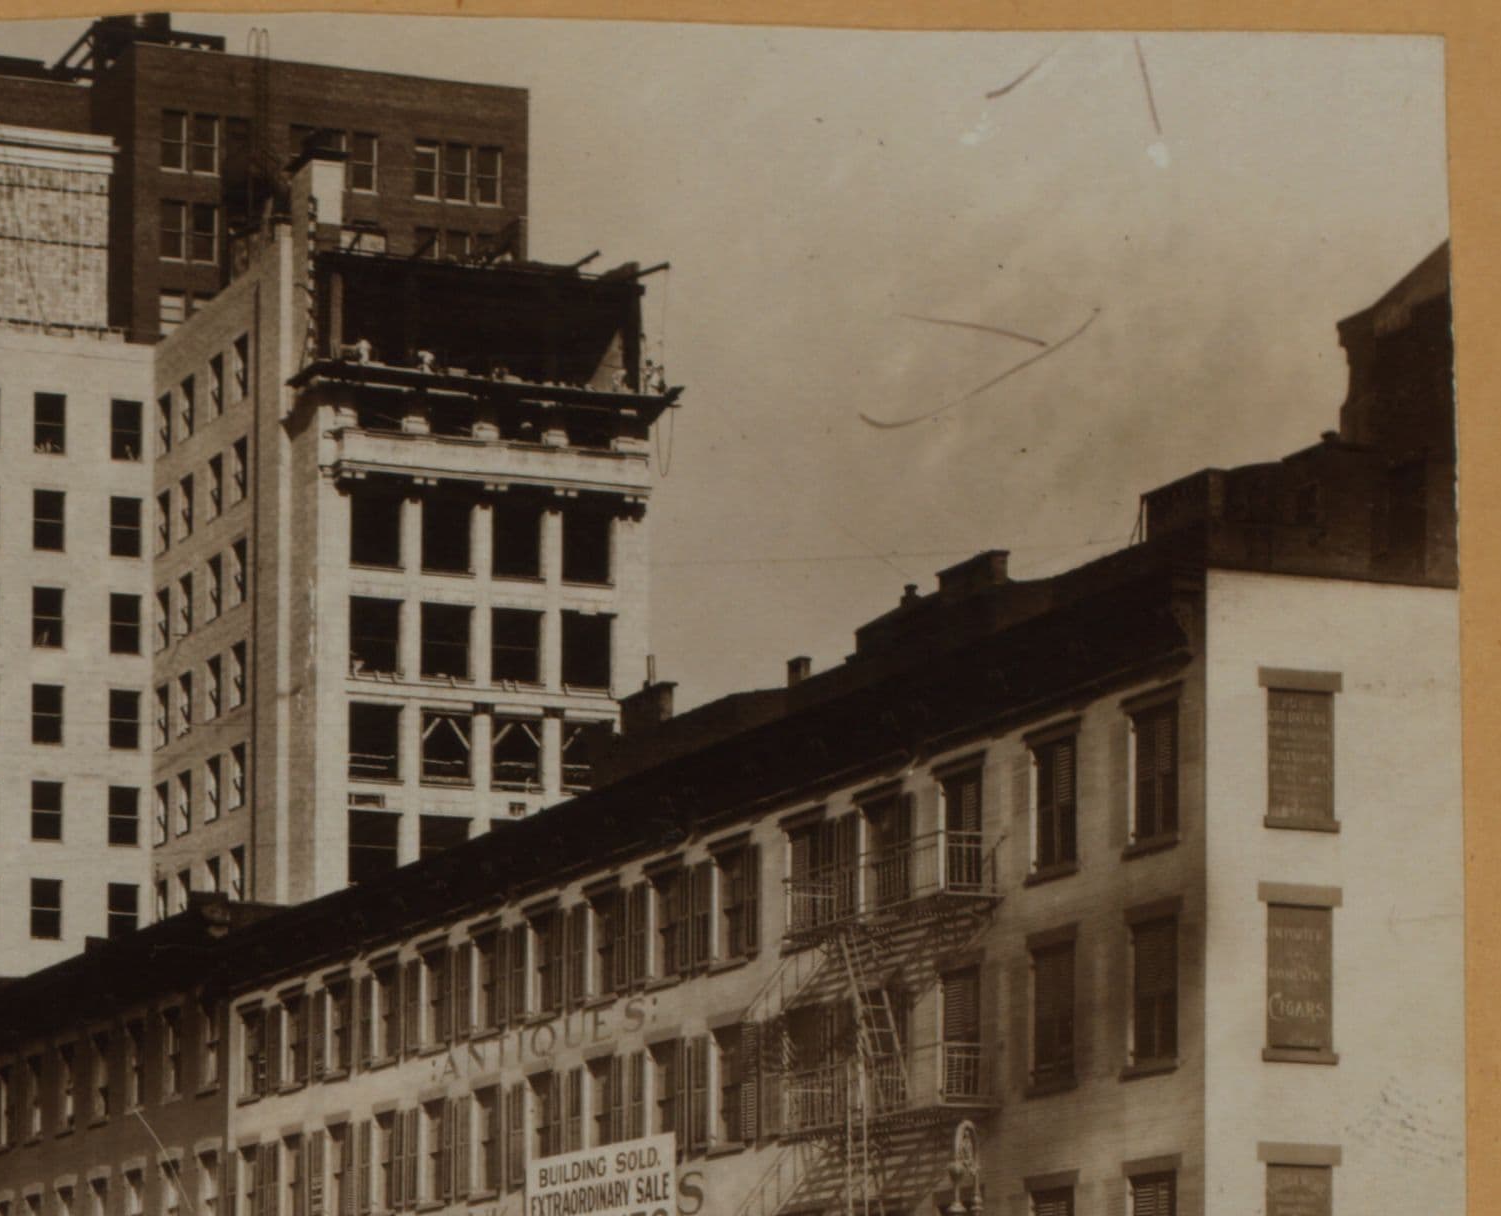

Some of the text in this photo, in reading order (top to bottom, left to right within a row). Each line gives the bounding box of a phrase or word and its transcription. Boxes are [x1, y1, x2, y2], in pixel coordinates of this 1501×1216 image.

[1267, 992, 1325, 1023] CIGARS
[538, 1147, 661, 1188] BUILDING SOLD.
[636, 1172, 670, 1204] SALE
